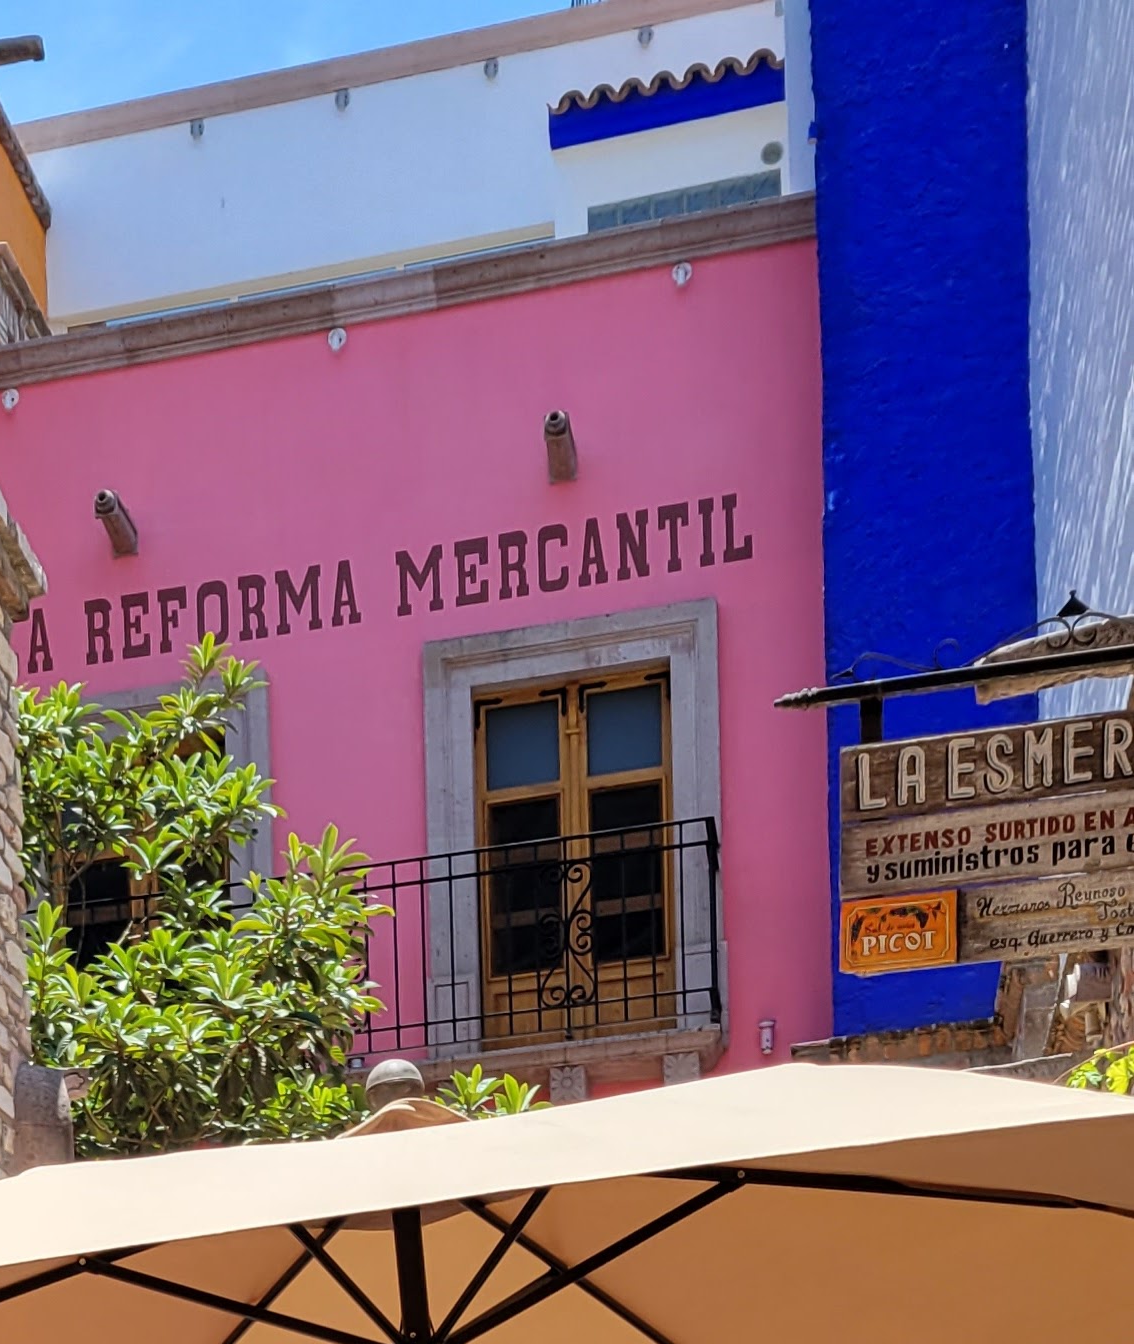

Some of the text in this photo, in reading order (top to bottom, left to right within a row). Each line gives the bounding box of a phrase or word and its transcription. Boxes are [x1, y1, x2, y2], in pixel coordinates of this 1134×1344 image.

[27, 493, 754, 674] A REFORMA MERCANTIL
[857, 718, 1134, 811] LA ESMER
[865, 827, 972, 857] EXTENSO
[985, 814, 1075, 844] SURTIDO
[1084, 810, 1115, 832] EN
[867, 864, 880, 884] y
[884, 844, 1040, 881] suministros
[1052, 836, 1115, 867] para
[976, 881, 1126, 918] Hermanos Reynoso
[861, 931, 937, 956] PICOT
[1027, 929, 1094, 948] Guerrero
[1099, 927, 1109, 943] y
